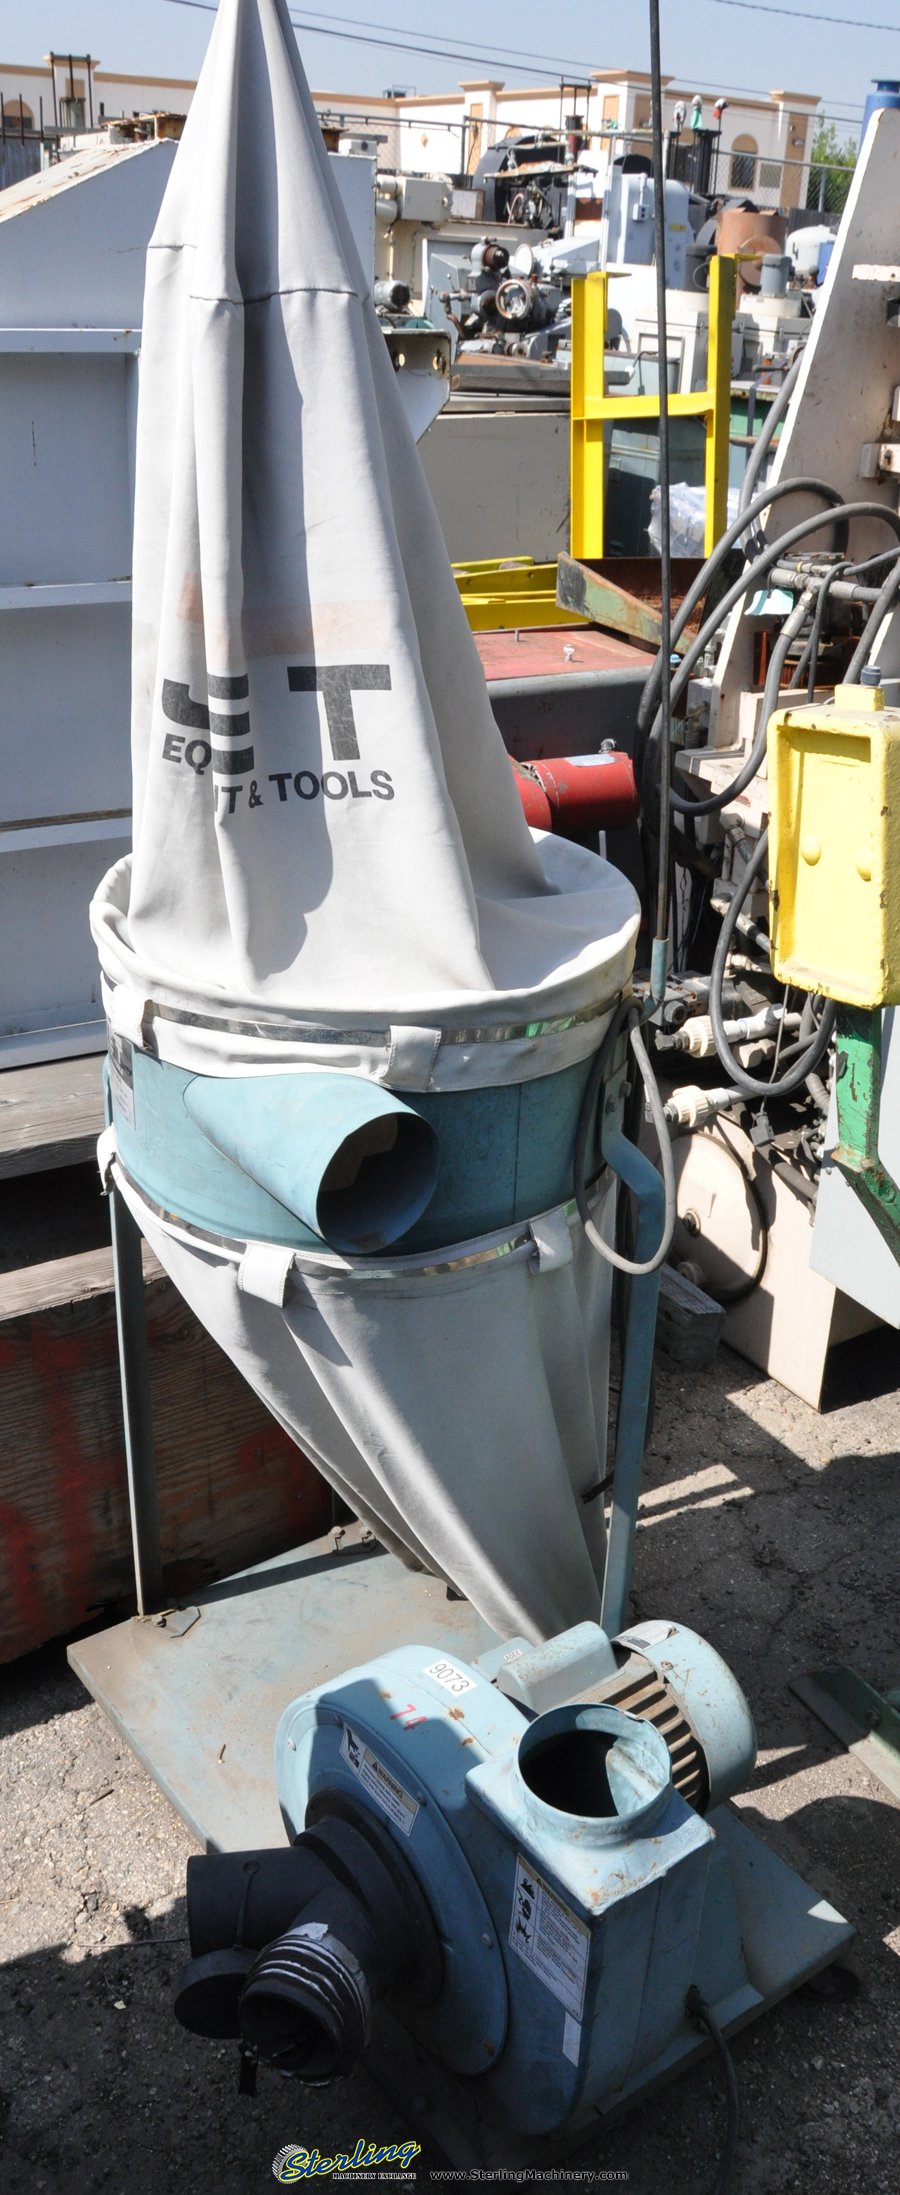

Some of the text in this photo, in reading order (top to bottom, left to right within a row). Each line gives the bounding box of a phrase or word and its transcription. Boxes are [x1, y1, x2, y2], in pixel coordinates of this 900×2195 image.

[248, 780, 264, 809] &
[268, 769, 395, 803] TOOLS
[429, 1663, 470, 1692] 9073
[377, 1765, 403, 1799] WARNING
